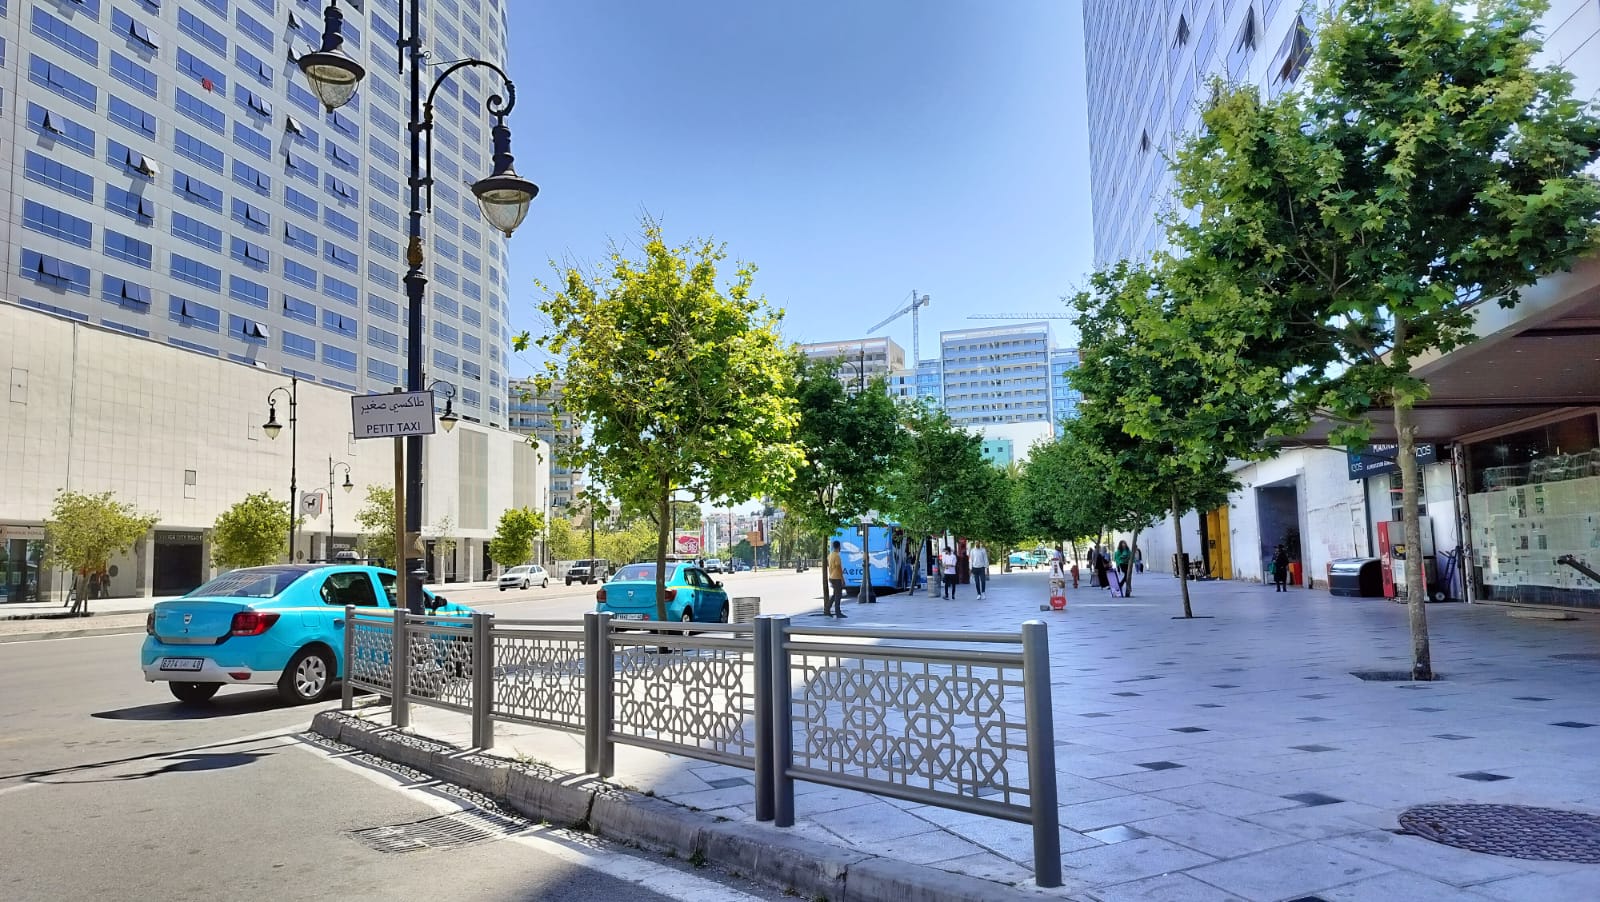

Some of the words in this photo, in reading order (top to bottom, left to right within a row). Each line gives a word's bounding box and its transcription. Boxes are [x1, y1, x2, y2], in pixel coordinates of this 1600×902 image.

[360, 400, 387, 415] صغير
[389, 396, 425, 413] طاكسي
[366, 423, 395, 434] PETIT
[397, 422, 421, 432] TAXI
